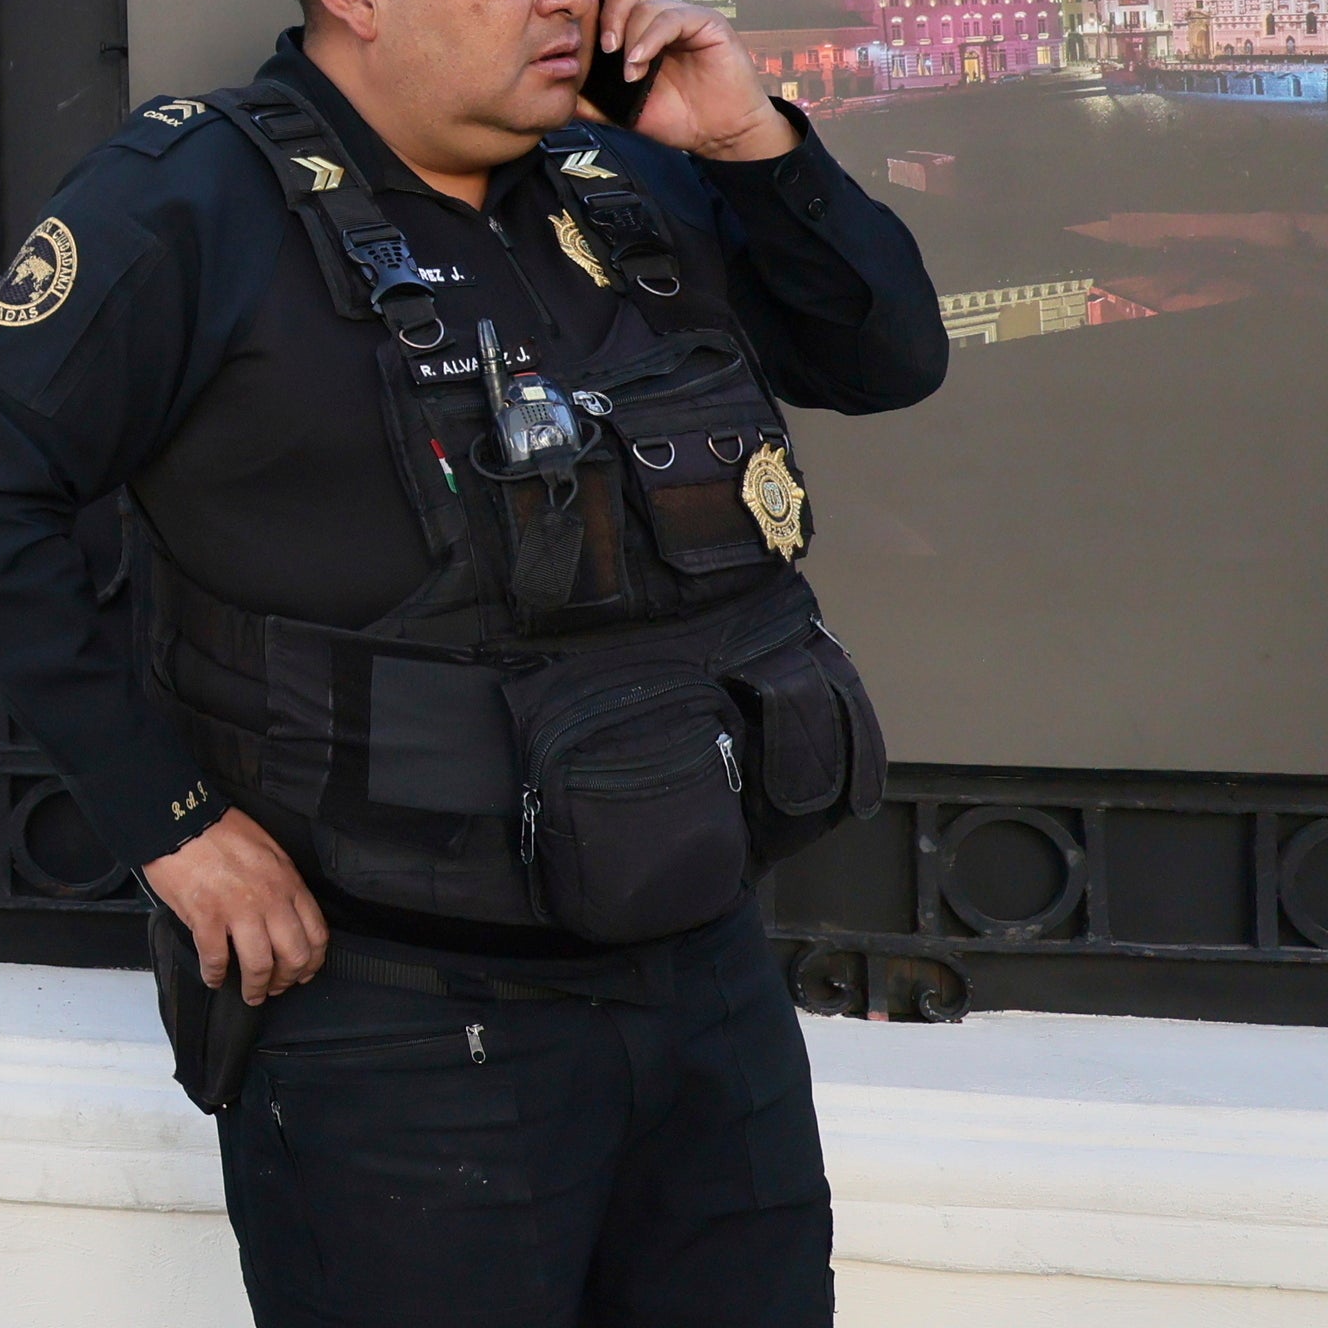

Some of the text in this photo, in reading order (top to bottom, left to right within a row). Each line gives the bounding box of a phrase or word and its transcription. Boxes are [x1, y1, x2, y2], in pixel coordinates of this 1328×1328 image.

[417, 267, 446, 282] REZ
[419, 346, 531, 378] R. ALVAZ J.
